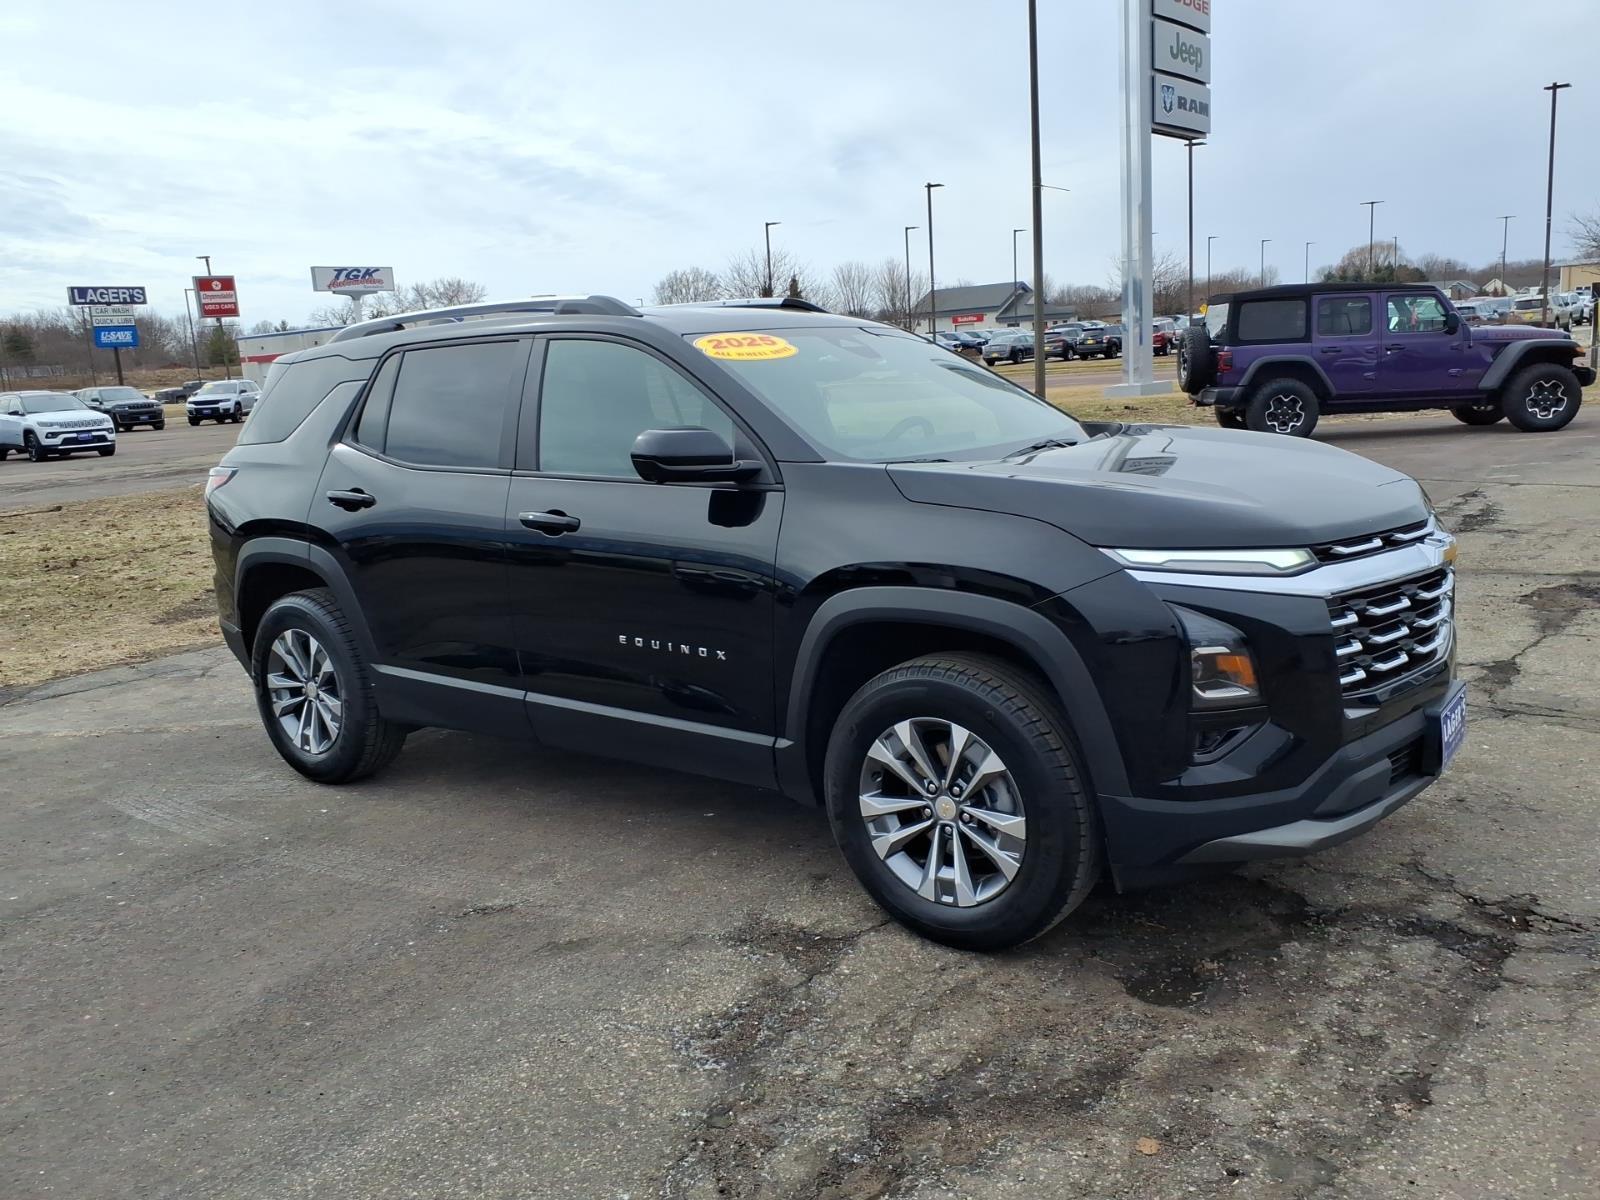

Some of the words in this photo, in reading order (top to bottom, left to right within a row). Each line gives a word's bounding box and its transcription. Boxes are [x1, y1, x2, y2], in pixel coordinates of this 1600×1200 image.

[1174, 0, 1209, 16] DGE
[1169, 31, 1203, 72] Jeep
[1177, 95, 1209, 117] RAM
[333, 268, 380, 281] TGK
[74, 289, 144, 303] LAGER'S
[707, 337, 777, 349] 2025
[619, 635, 726, 660] EQUINOX
